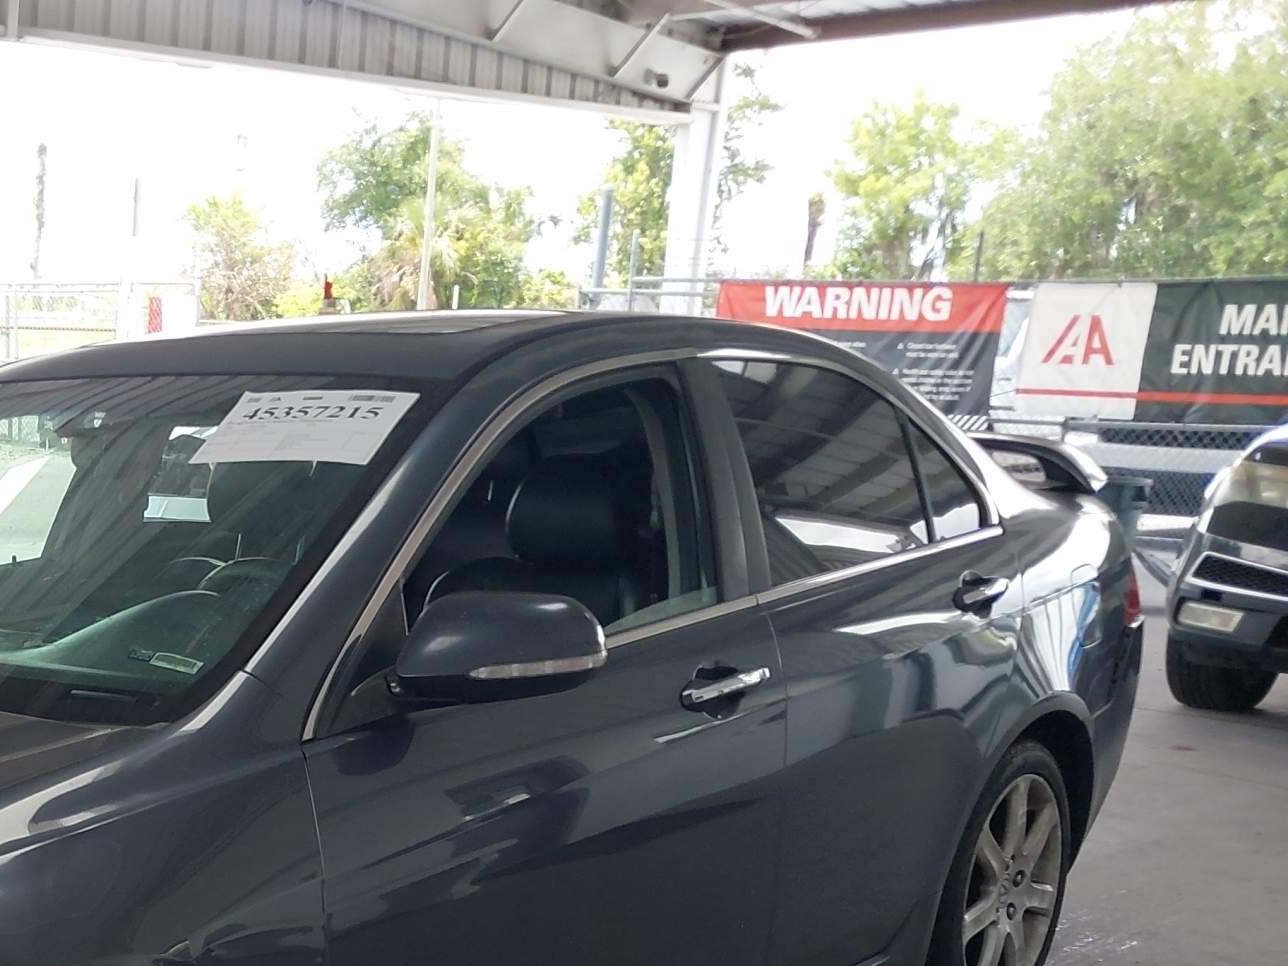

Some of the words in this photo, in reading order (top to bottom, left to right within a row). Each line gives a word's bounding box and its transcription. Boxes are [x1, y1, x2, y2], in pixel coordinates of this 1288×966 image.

[764, 285, 953, 322] WARNING
[1169, 343, 1288, 377] ENTRA
[242, 405, 385, 421] 45357215
